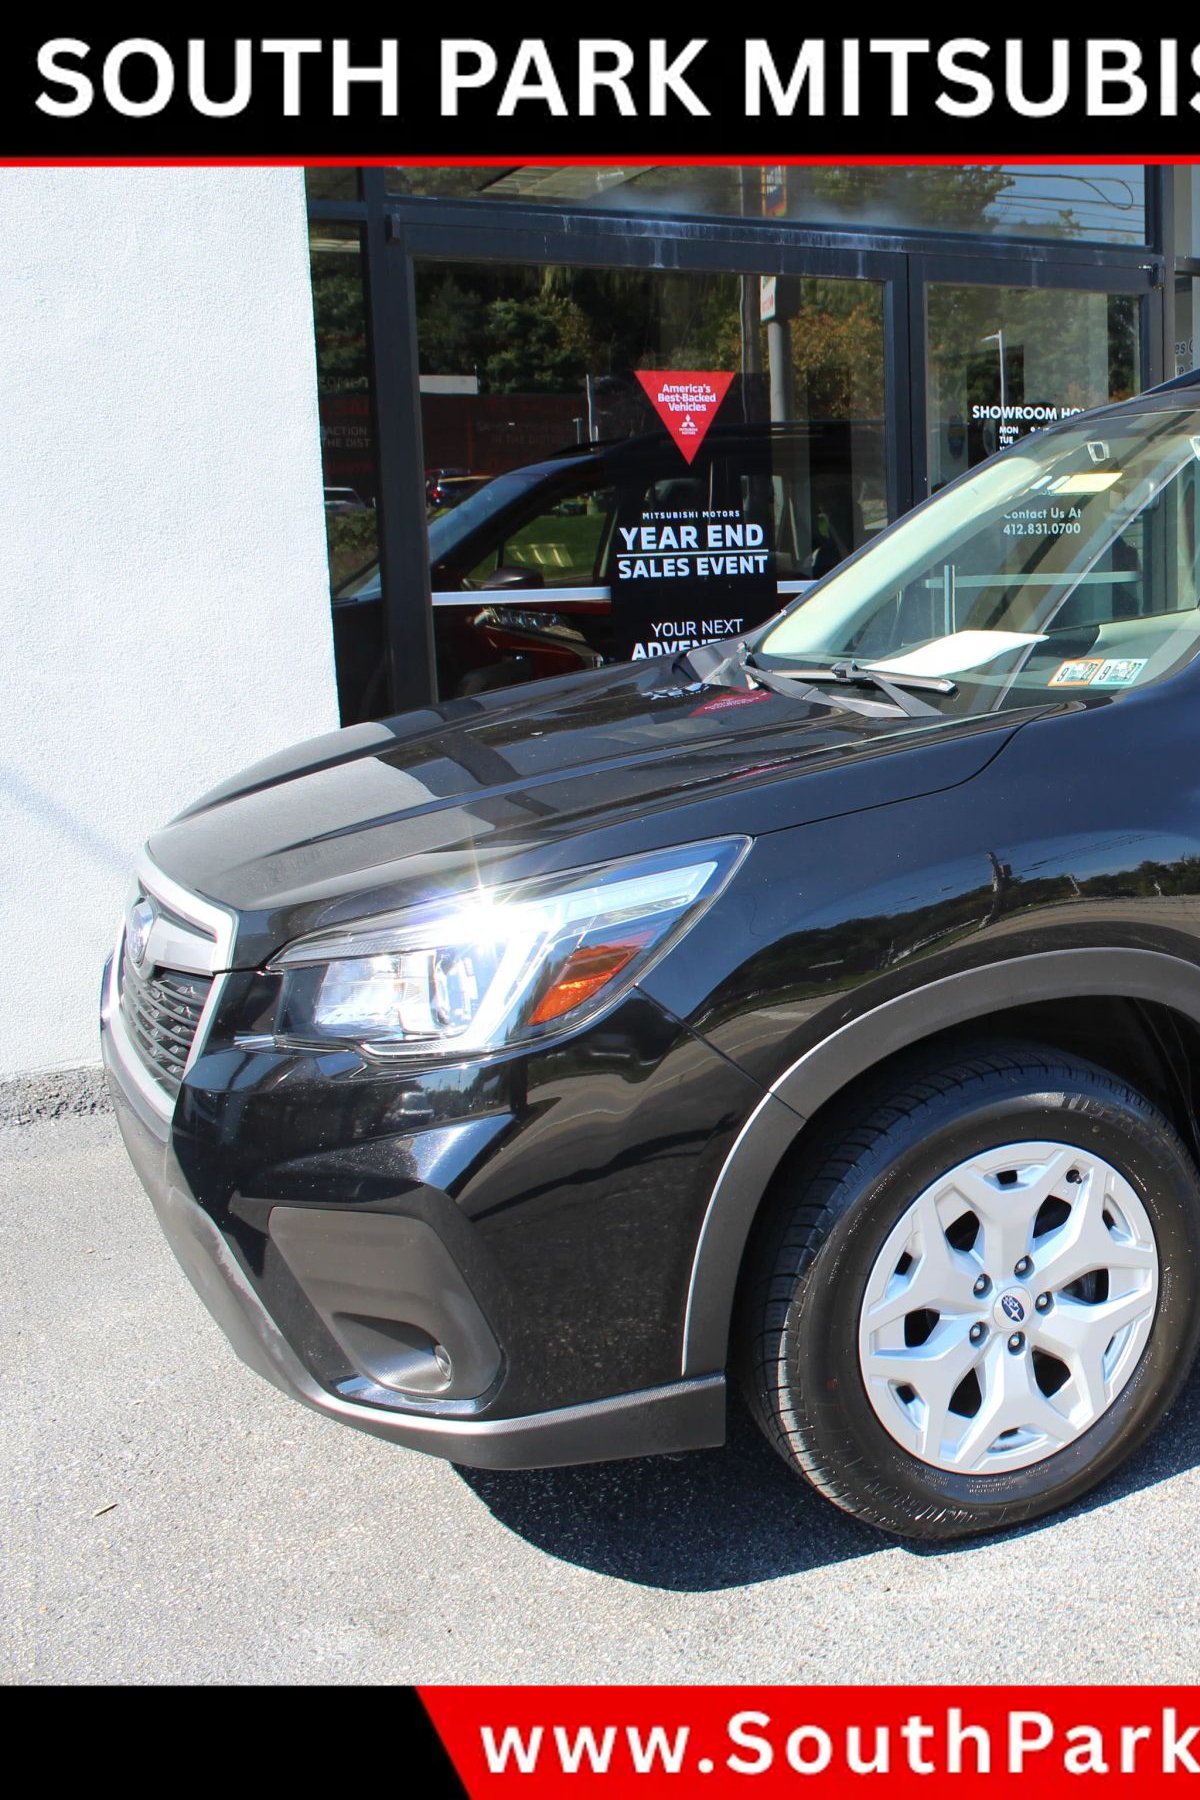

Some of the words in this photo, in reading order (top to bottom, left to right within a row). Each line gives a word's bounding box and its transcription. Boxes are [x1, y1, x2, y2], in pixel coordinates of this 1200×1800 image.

[662, 384, 711, 393] America's
[657, 393, 717, 402] Best-Backed
[668, 402, 707, 412] Vehicles
[972, 405, 1058, 420] SHOWROOM
[999, 426, 1019, 434] MON
[999, 435, 1014, 445] TUE
[642, 511, 699, 520] MITSUBISHI
[702, 510, 740, 518] MOTORS
[1051, 507, 1064, 519] Us
[1068, 507, 1081, 518] At
[1003, 522, 1081, 535] 412.831.0700
[619, 525, 699, 551] YEAR
[707, 523, 764, 548] END
[618, 558, 690, 579] SALES
[696, 555, 768, 576] EVENT
[651, 621, 697, 638] YOUR
[702, 618, 744, 634] NEXT
